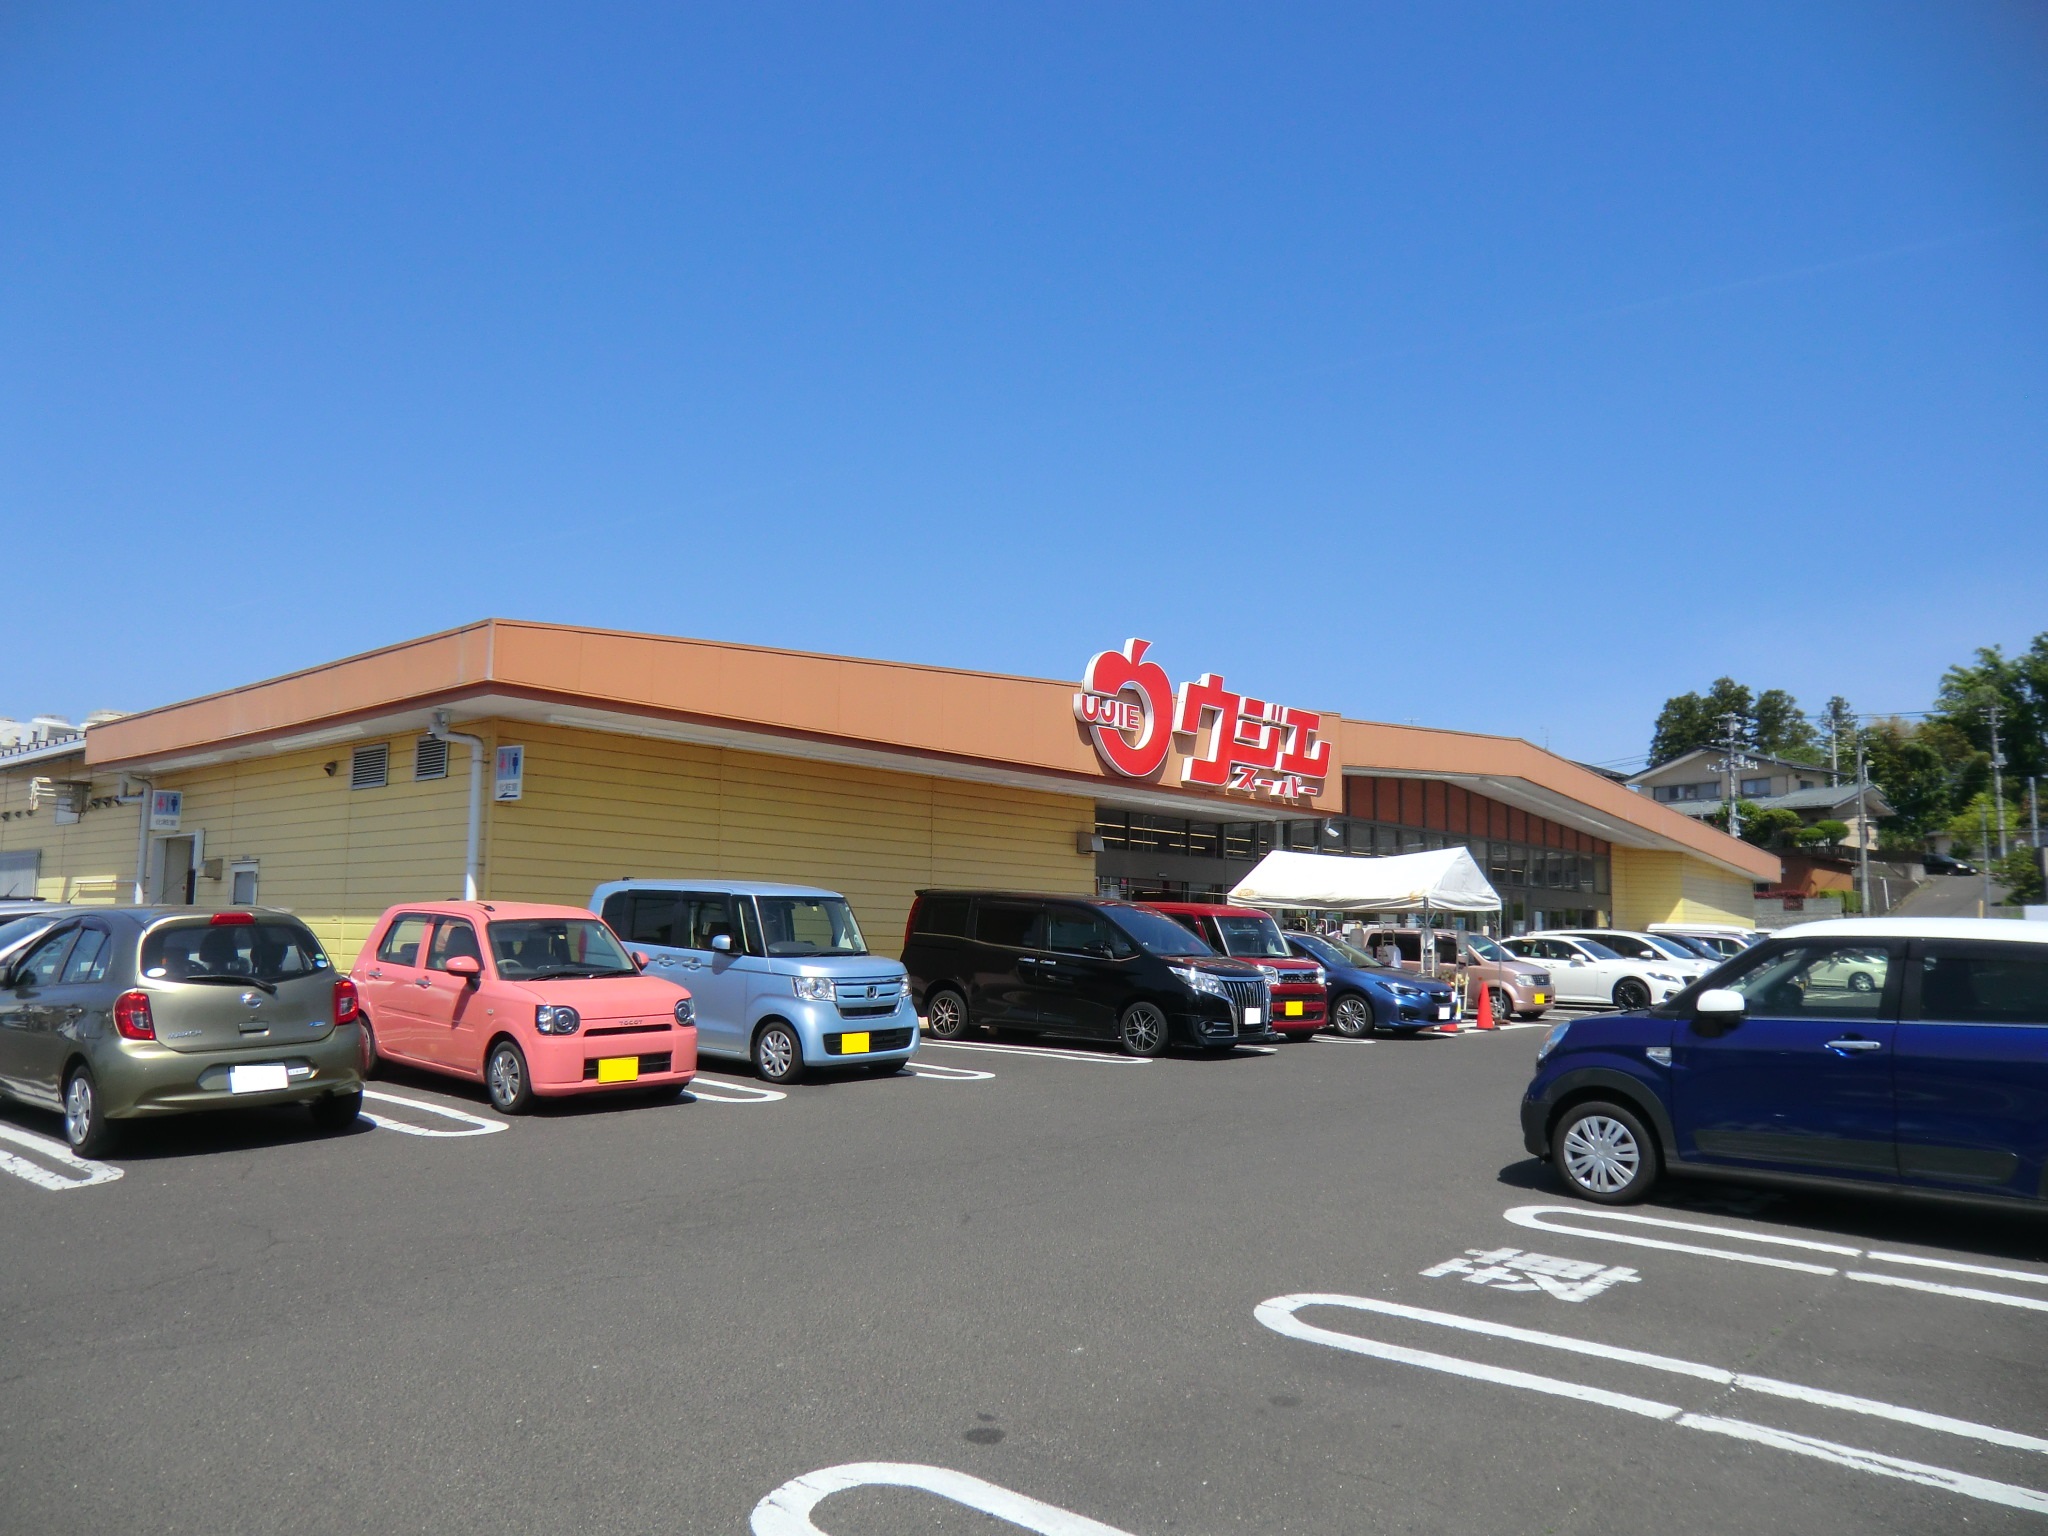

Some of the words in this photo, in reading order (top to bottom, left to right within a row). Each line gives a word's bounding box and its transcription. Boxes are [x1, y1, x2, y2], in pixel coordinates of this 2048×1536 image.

[1081, 694, 1140, 731] UJIE
[1179, 673, 1332, 787] ウジエ
[1233, 766, 1319, 799] スーパー
[1418, 1247, 1642, 1303] 軽
